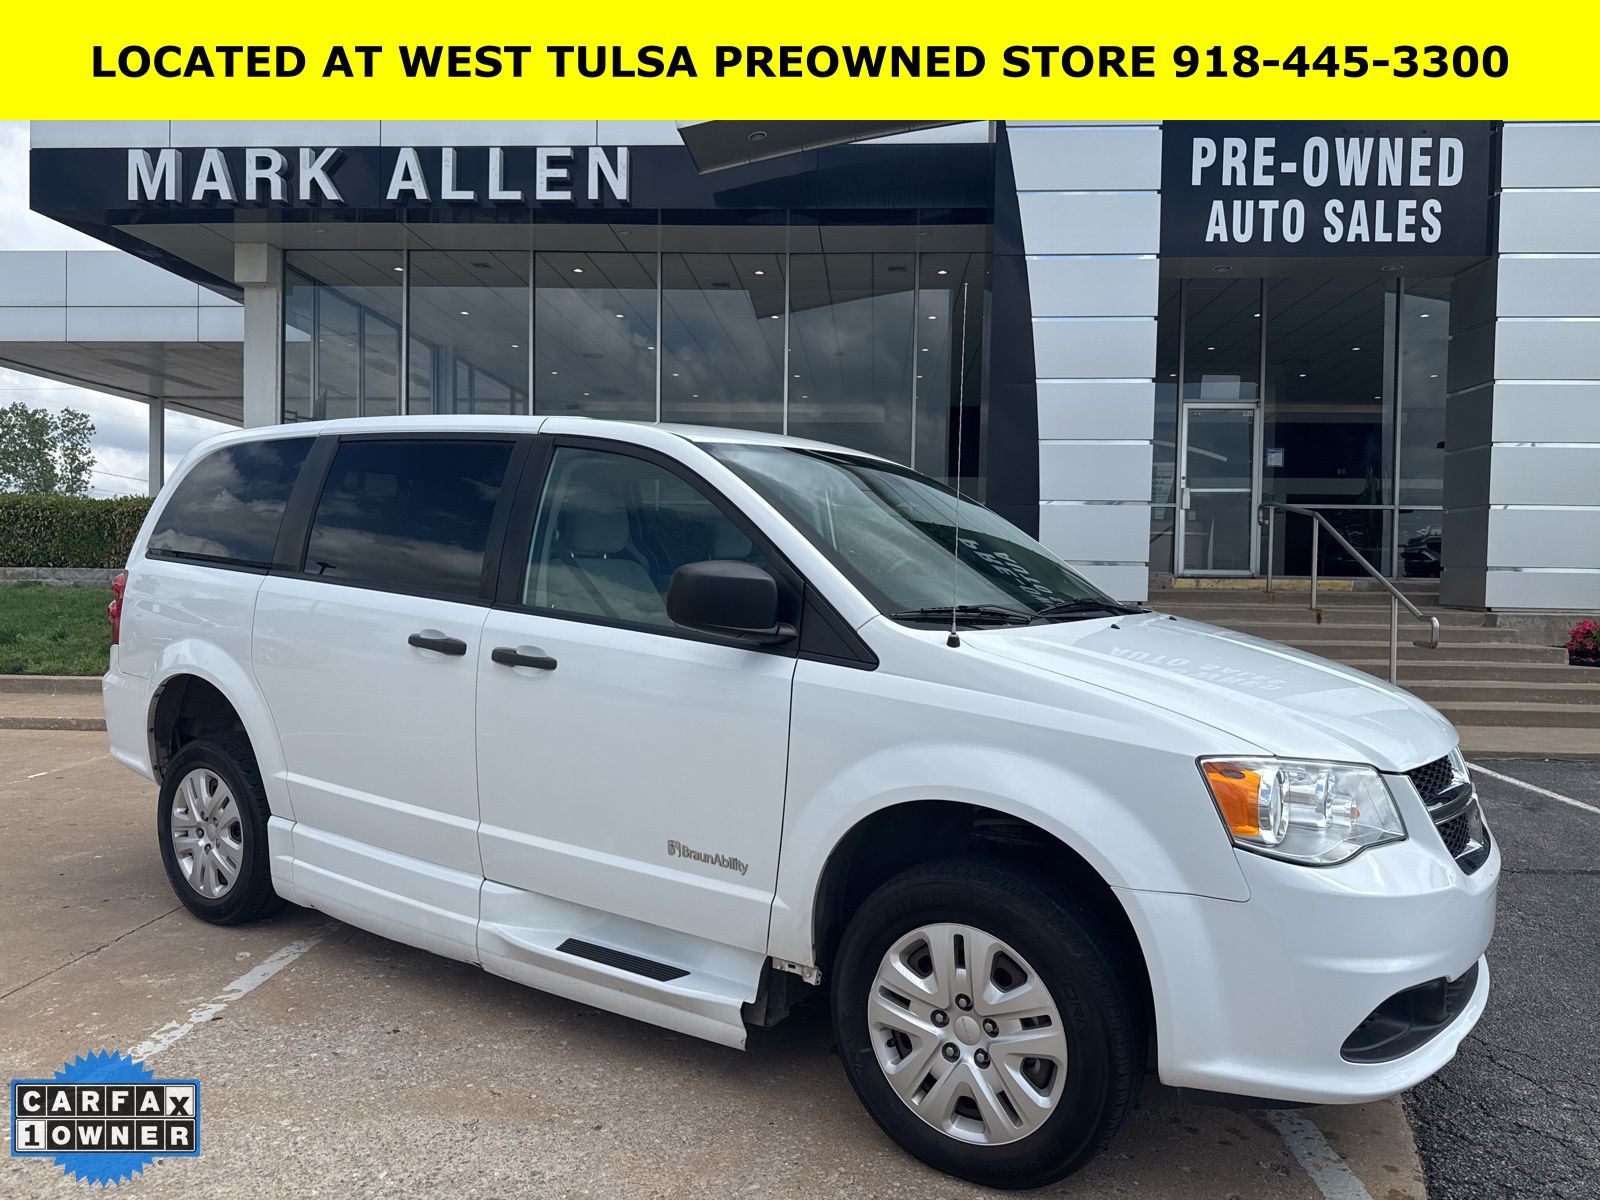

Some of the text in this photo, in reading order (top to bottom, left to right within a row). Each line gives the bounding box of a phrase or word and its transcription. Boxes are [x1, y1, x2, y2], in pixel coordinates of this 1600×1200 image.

[127, 146, 631, 202] MARK ALLEN
[1191, 136, 1464, 187] PRE-OWNED
[1205, 199, 1442, 243] AUTO SALES
[681, 844, 749, 876] BraunAbility
